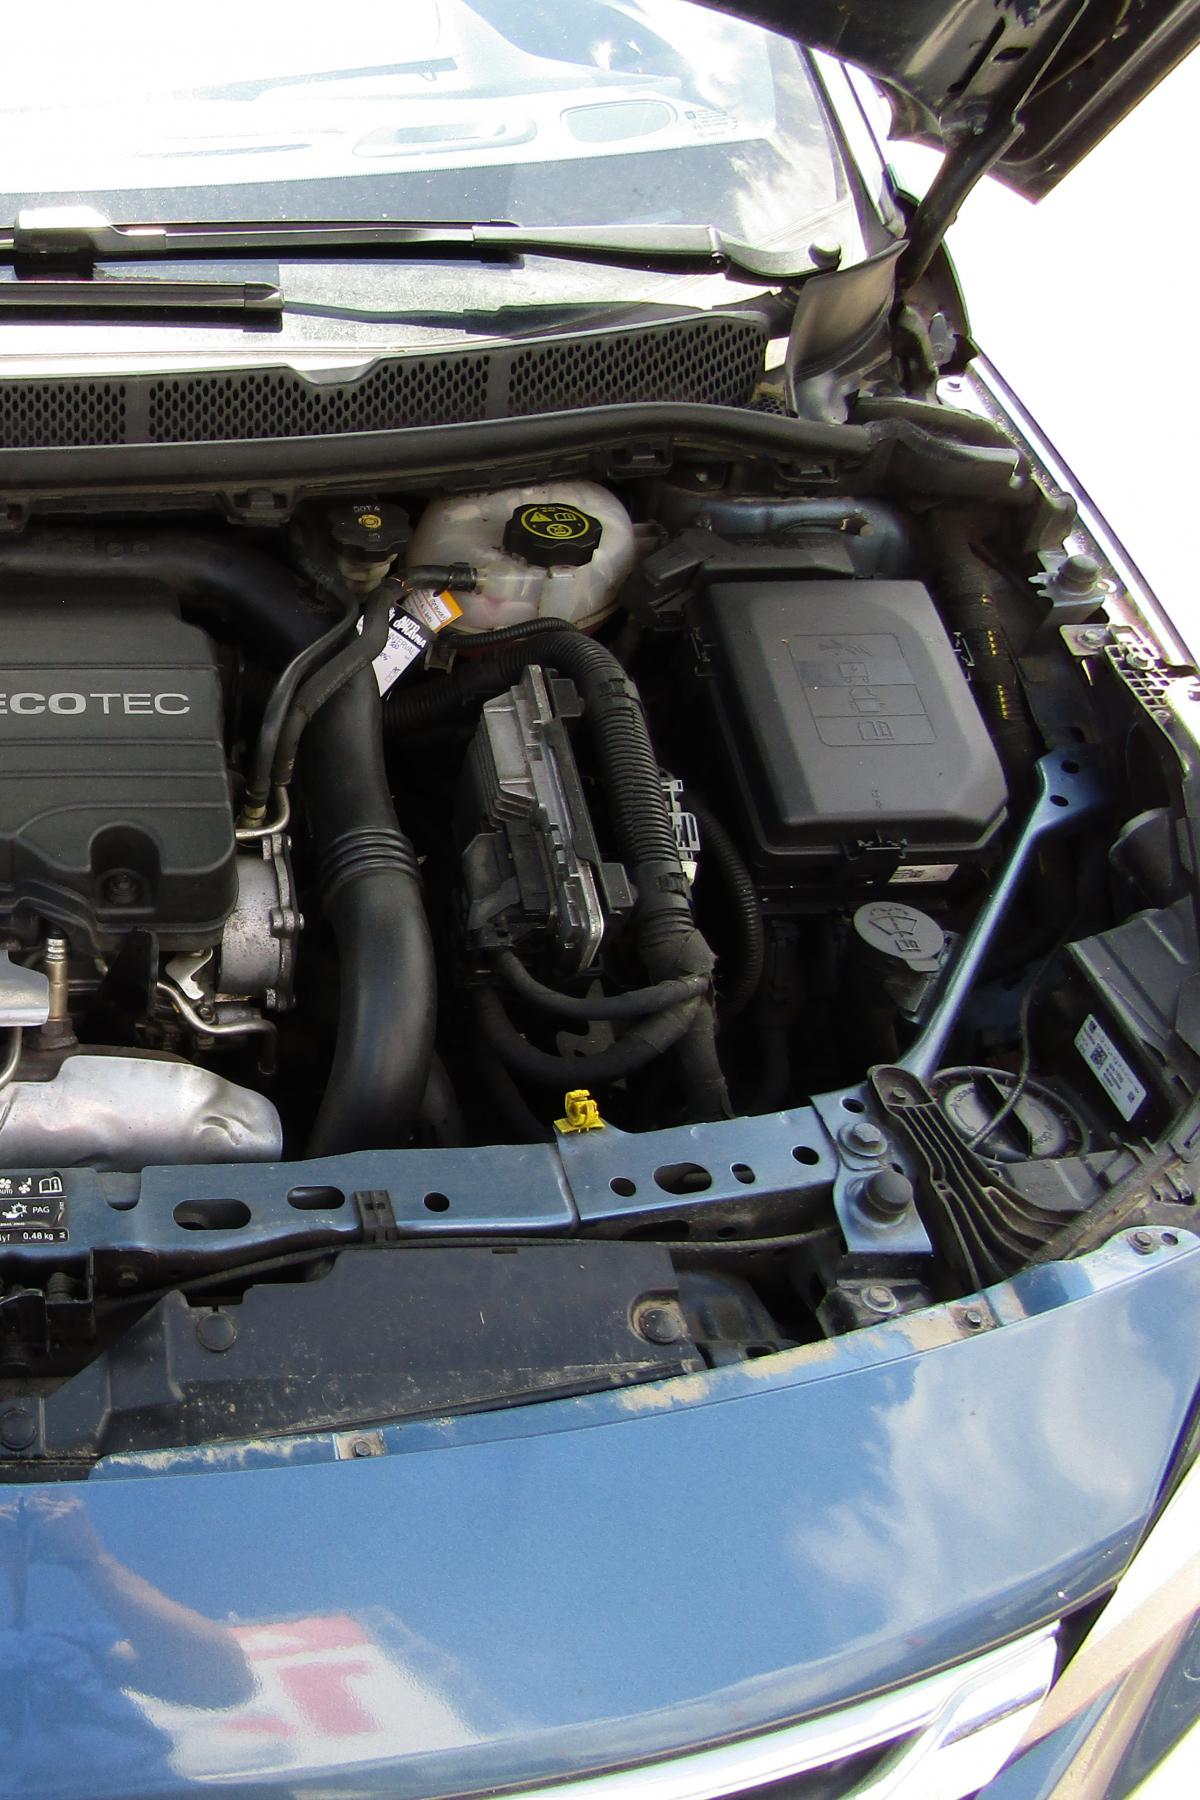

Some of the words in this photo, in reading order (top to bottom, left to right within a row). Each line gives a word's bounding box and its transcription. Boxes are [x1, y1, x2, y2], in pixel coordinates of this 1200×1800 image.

[400, 615, 420, 632] AUTO
[32, 1206, 50, 1214] PAG
[44, 1232, 54, 1241] kg
